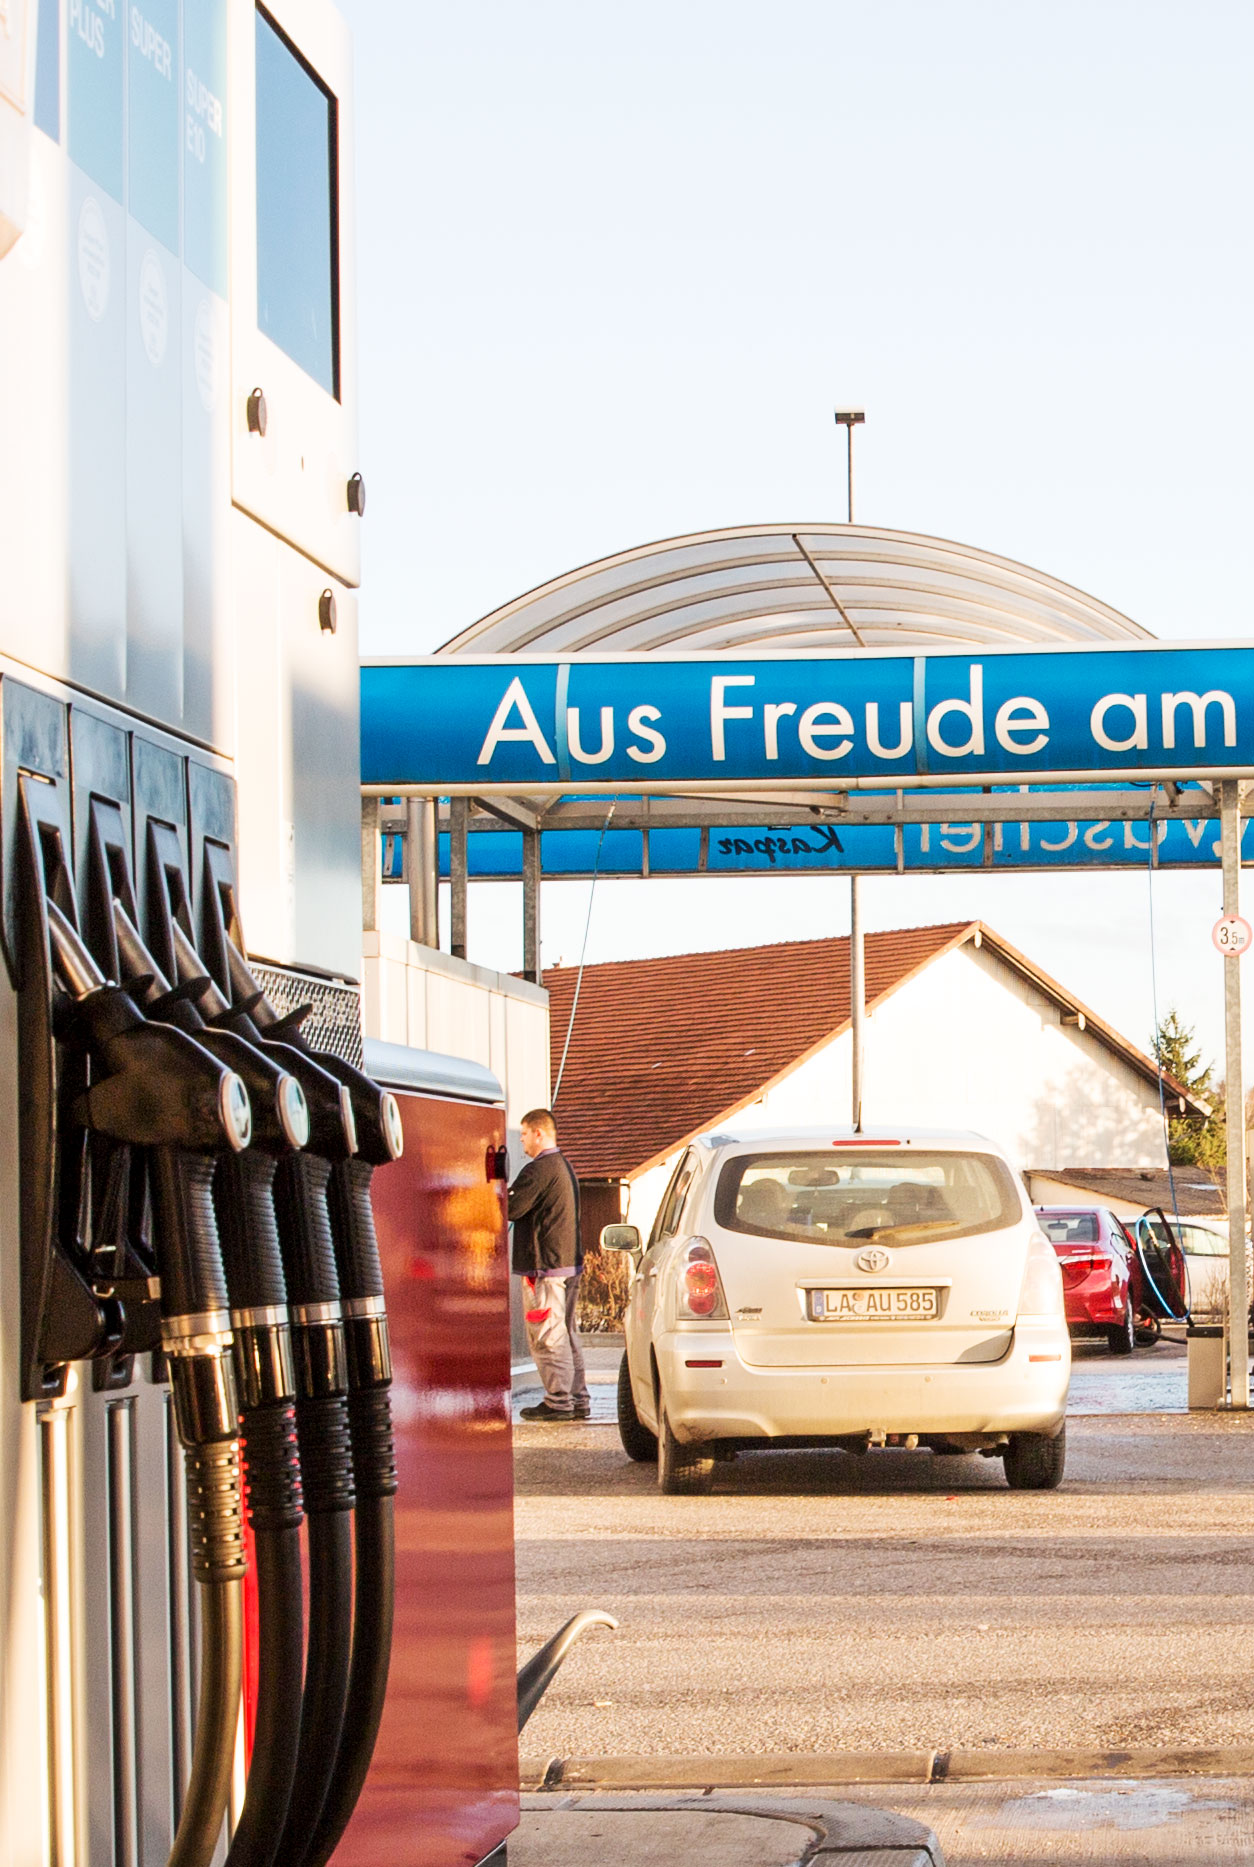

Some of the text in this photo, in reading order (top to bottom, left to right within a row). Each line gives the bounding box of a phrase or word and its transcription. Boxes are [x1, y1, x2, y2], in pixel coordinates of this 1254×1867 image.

[130, 5, 172, 82] SUPER
[186, 67, 222, 138] SUPER
[186, 113, 206, 164] E10
[476, 676, 667, 765] Aus
[710, 664, 1050, 761] Freude
[1090, 690, 1237, 752] am
[825, 1292, 934, 1313] LA AU 585
